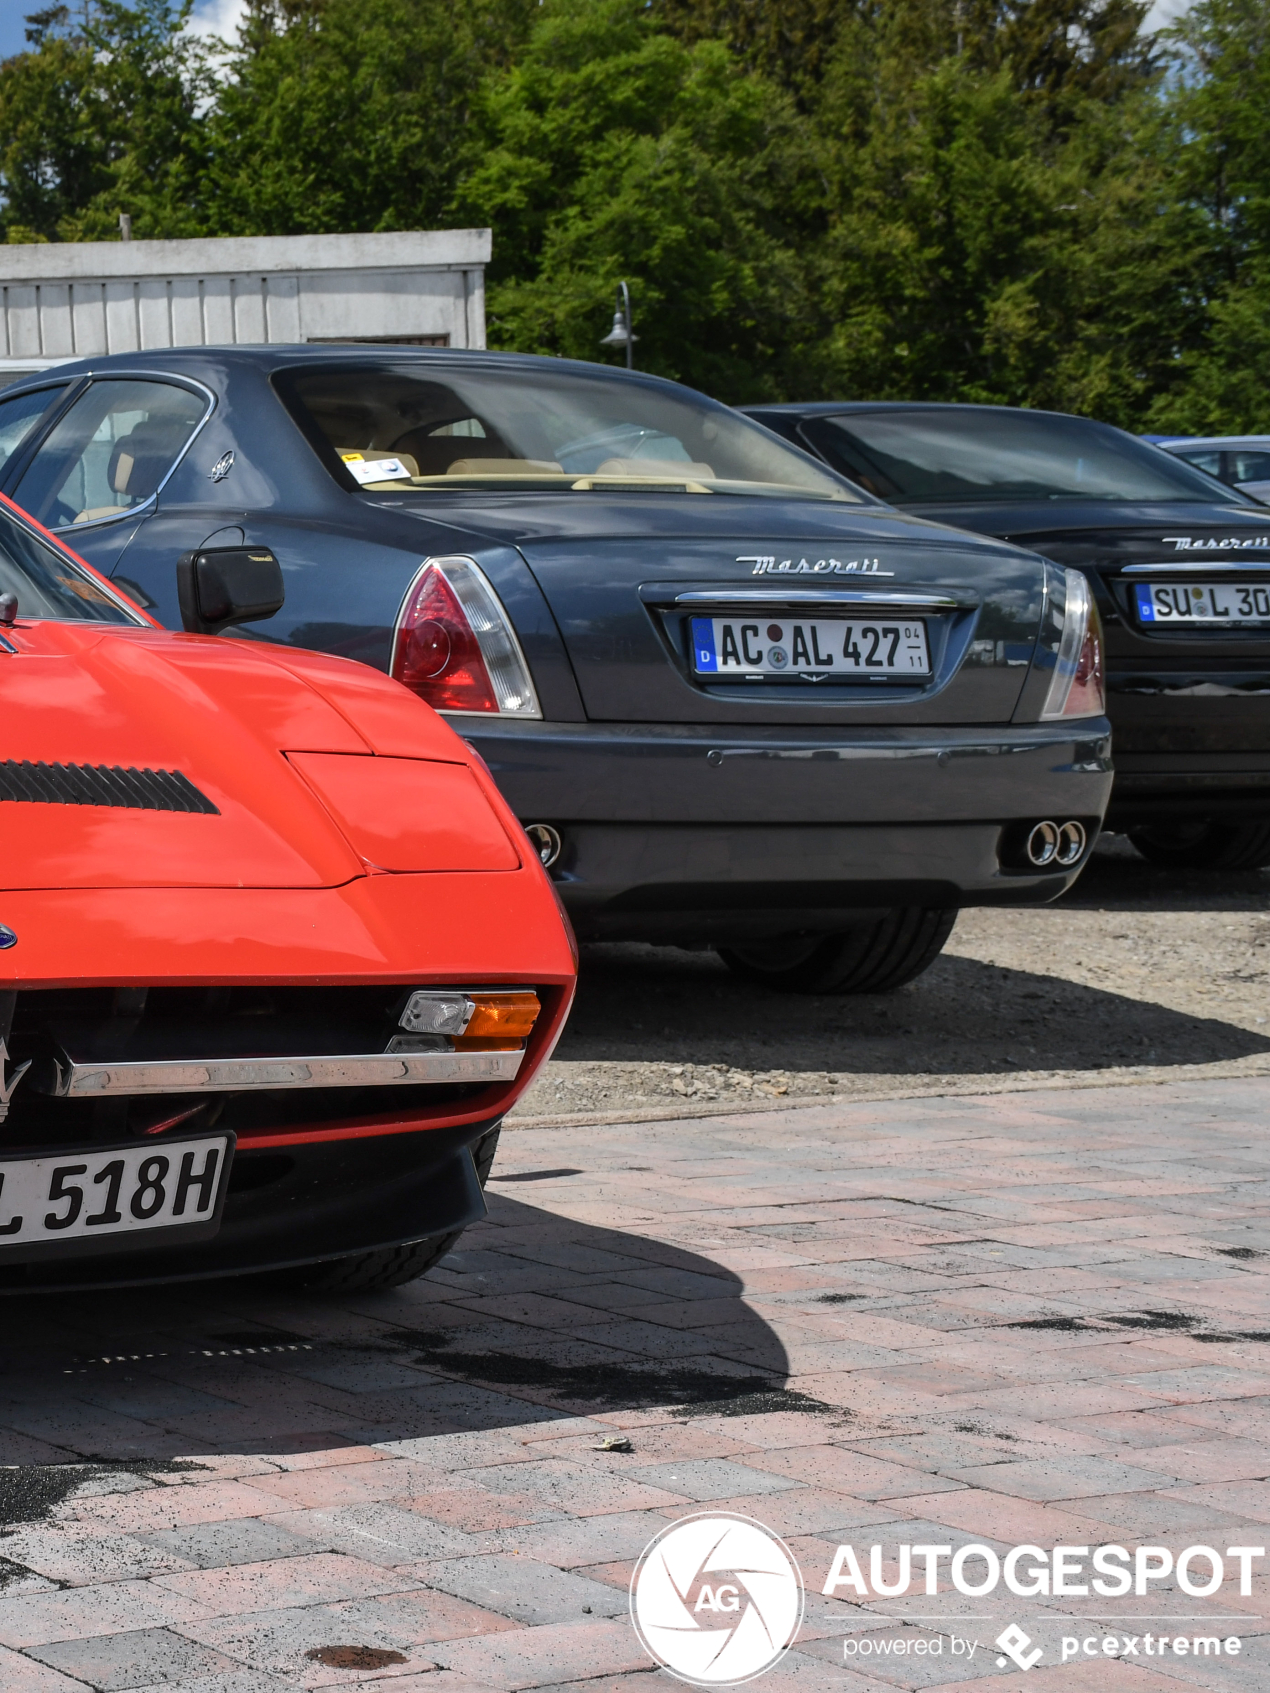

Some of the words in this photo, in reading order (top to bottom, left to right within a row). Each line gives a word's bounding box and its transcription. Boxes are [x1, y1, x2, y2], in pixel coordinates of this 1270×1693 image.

[1162, 536, 1270, 551] Maserati
[735, 556, 895, 577] Maserati
[1154, 588, 1192, 617] SU
[1208, 588, 1229, 617] L
[1235, 588, 1270, 617] 30
[1142, 606, 1150, 616] D
[904, 627, 920, 639] 04
[721, 624, 763, 666] AC
[792, 625, 834, 667] AL
[842, 626, 901, 667] 427
[700, 650, 710, 663] D
[909, 655, 922, 667] 11
[43, 1148, 220, 1231] 518H
